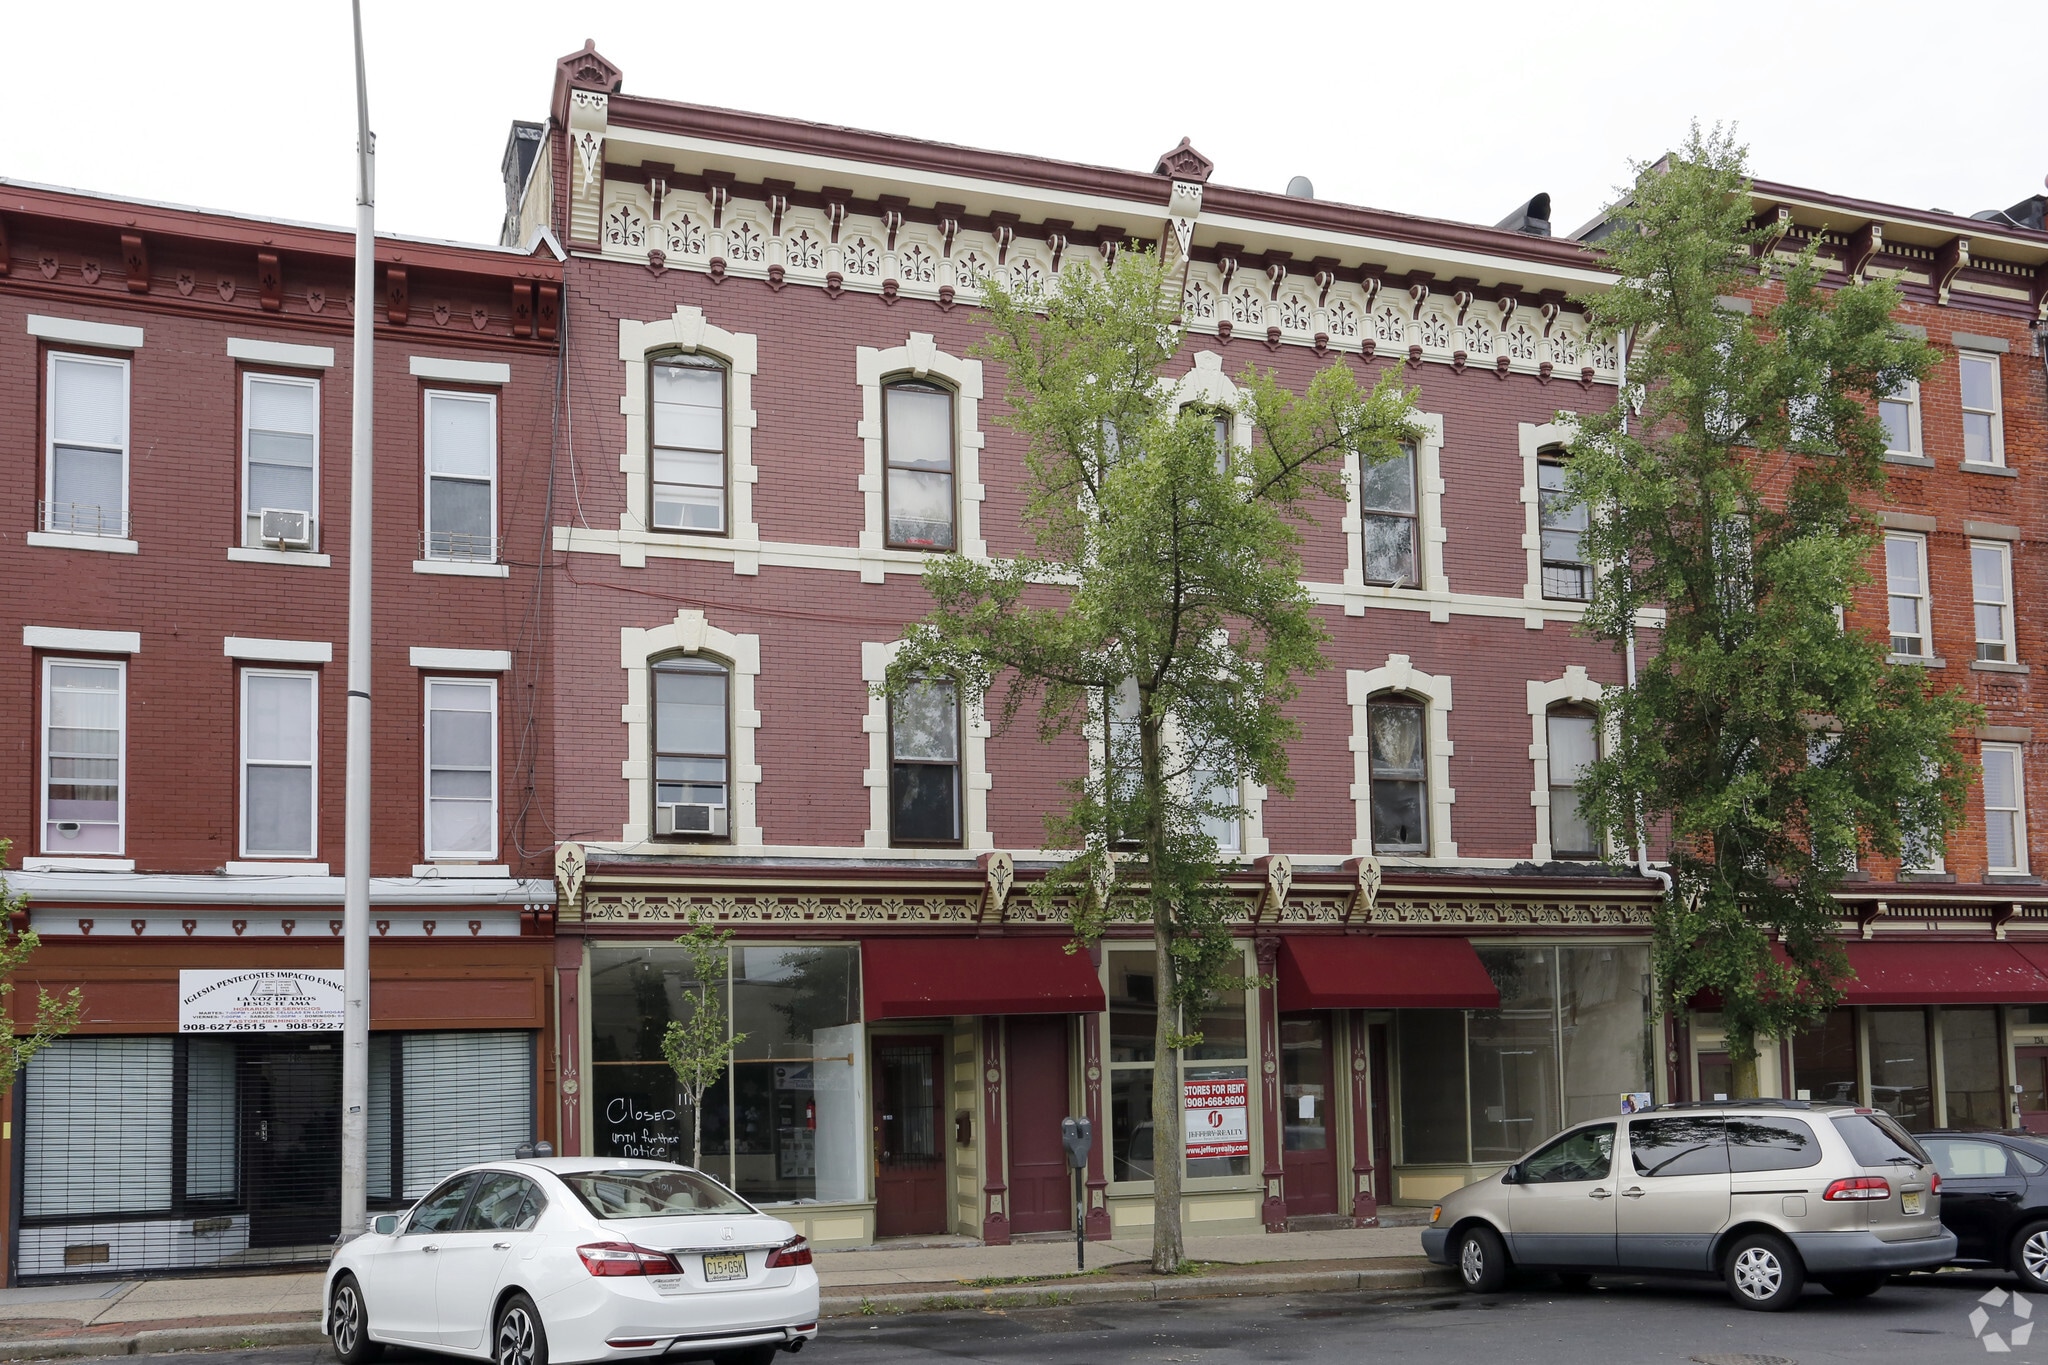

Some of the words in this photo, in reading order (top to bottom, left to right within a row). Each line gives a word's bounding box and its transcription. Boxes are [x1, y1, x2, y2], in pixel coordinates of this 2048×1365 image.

[184, 985, 216, 1005] IGLESIA
[216, 971, 275, 989] PENTECOSTES
[277, 971, 315, 982] IMPACTO
[317, 977, 344, 993] EVANG
[183, 1023, 266, 1031] 908-627-6515
[286, 1022, 344, 1030] 908-922-7
[1184, 1085, 1211, 1096] STORES
[1212, 1084, 1226, 1095] FOR
[1227, 1083, 1245, 1094] RENT
[1184, 1096, 1245, 1108] (908)-668-9600
